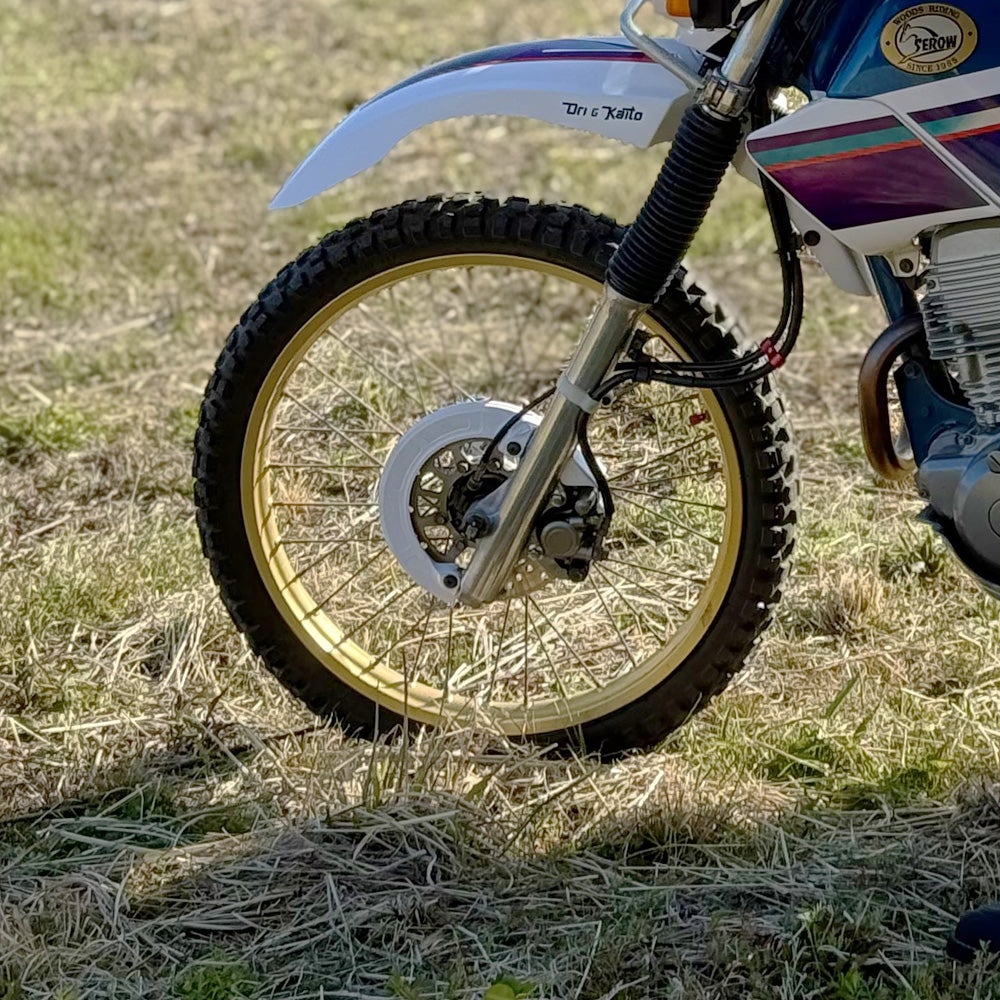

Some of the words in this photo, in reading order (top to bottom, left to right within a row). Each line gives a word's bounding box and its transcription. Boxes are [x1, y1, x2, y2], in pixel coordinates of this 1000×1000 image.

[892, 6, 924, 26] WOODS
[928, 4, 960, 20] RIDING
[914, 35, 957, 52] SEROW
[906, 62, 933, 73] SINCE
[602, 106, 643, 121] Kaito
